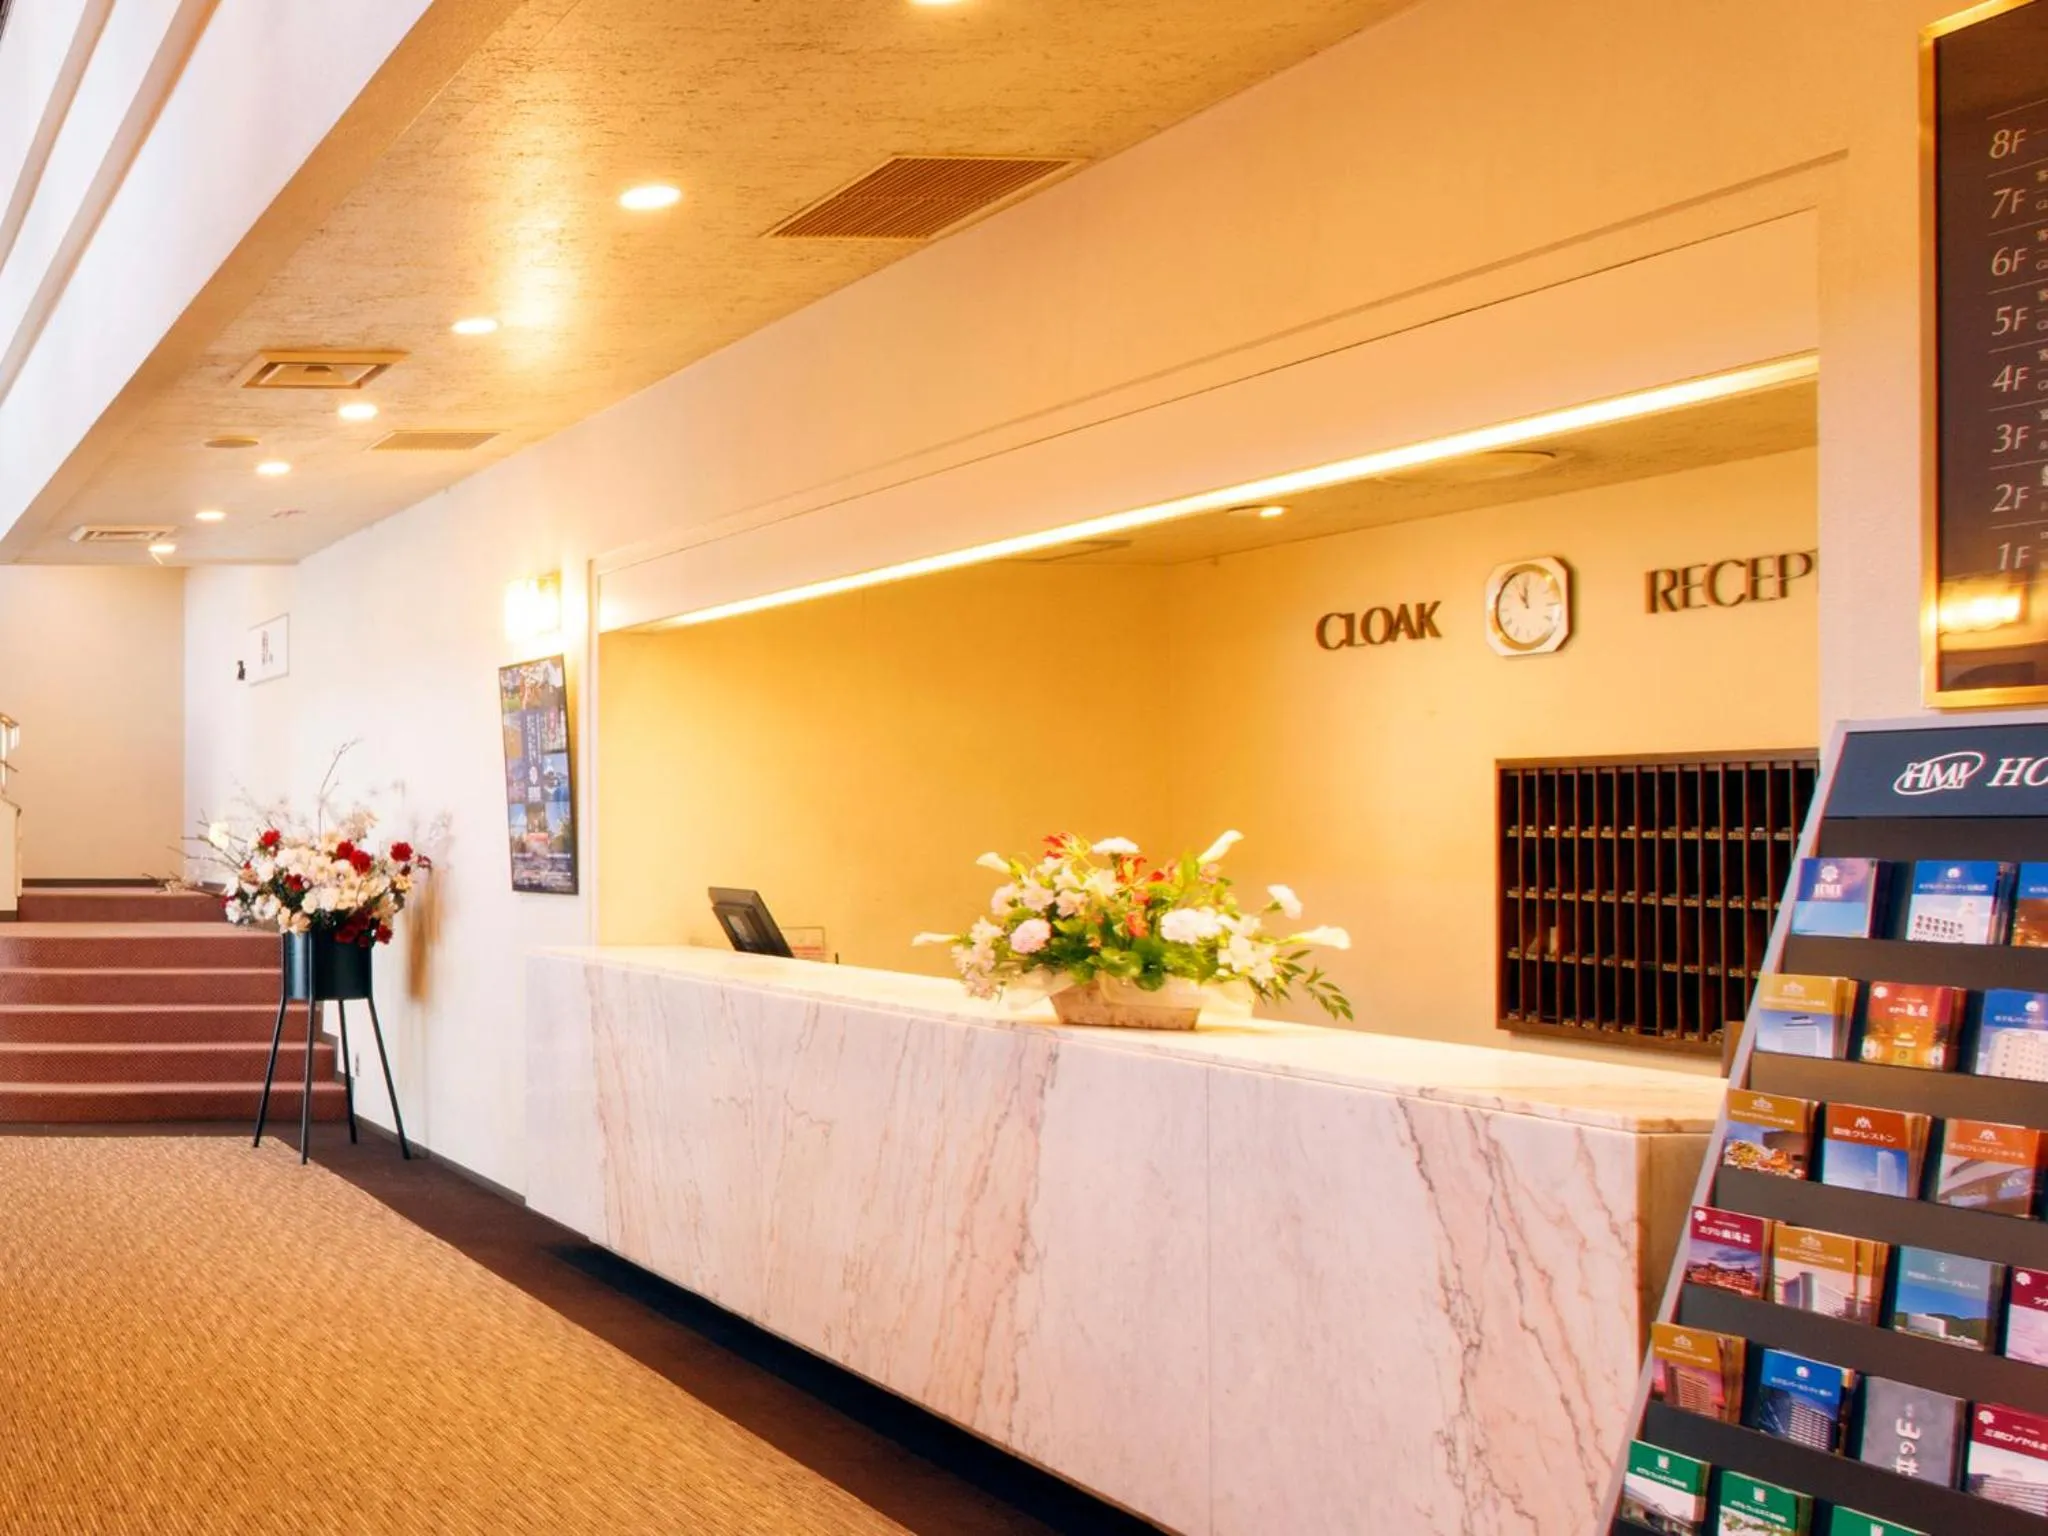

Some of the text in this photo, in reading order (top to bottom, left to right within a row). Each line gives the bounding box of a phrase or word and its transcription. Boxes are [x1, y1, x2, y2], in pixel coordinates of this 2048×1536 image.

[1989, 128, 2027, 159] 8F
[1990, 188, 2027, 219] 7F
[1991, 247, 2028, 276] 6F
[1991, 306, 2029, 336] 5F
[1992, 365, 2029, 393] 4F
[1992, 424, 2030, 453] 3F
[1992, 483, 2030, 513] 2F
[1997, 542, 2031, 571] 1F
[1645, 549, 1819, 614] RECEP
[1315, 600, 1443, 651] CLOAK
